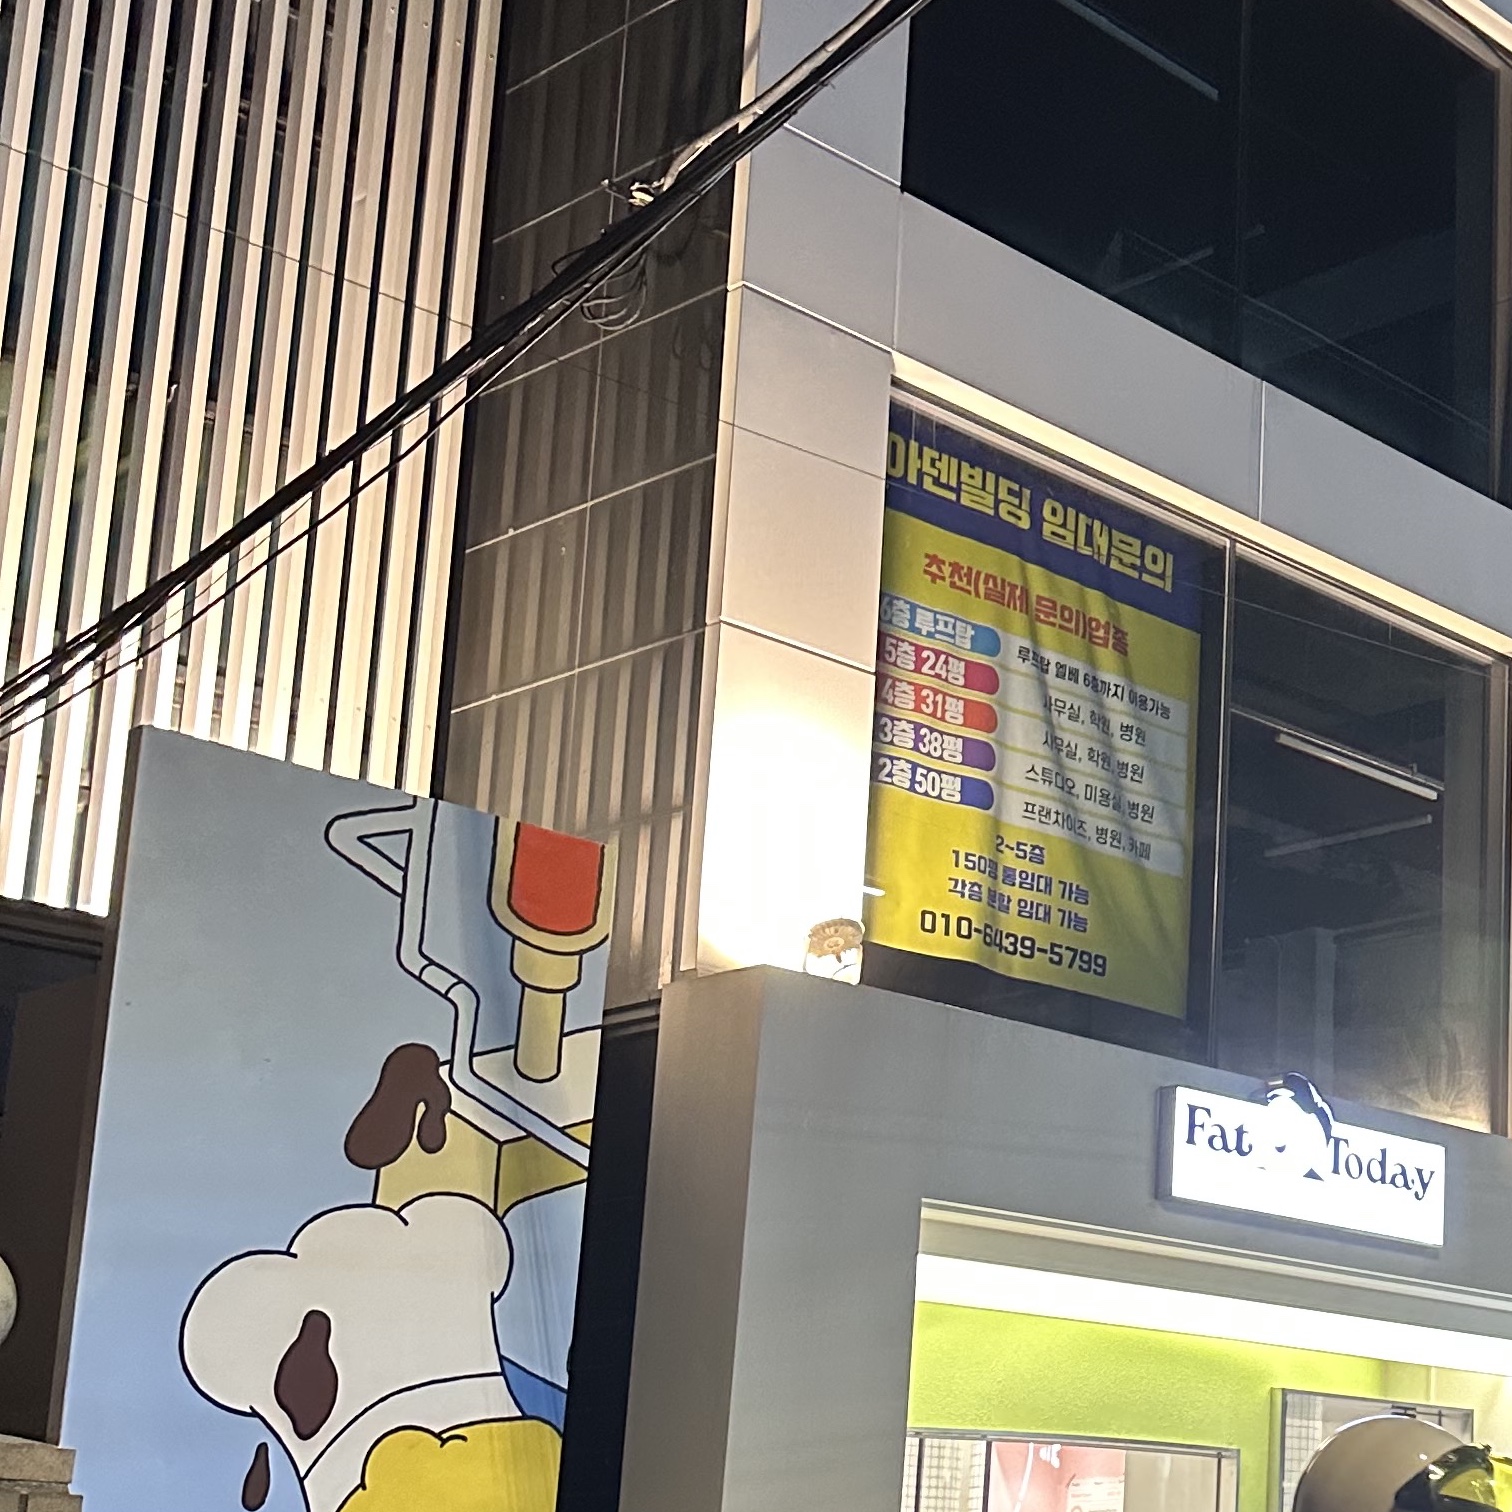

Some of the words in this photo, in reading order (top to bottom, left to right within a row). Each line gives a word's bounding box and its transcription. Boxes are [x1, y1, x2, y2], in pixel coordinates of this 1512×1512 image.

[887, 431, 1032, 531] 아덴빌딩
[1042, 498, 1174, 594] 임대문의
[923, 552, 1030, 616] 추천(실제
[880, 596, 911, 629] 6층
[915, 607, 976, 650] 루프탑
[884, 636, 916, 671] 5층
[920, 649, 966, 687] 24평
[881, 677, 916, 710] 4층
[920, 688, 965, 726] 31평
[878, 716, 916, 749] 3층
[918, 727, 964, 764] 38평
[1119, 721, 1147, 747] 병원
[877, 757, 913, 789] 2층
[914, 766, 962, 803] 50평
[1116, 759, 1145, 784] 병원
[995, 834, 1046, 865] 2~5층
[952, 849, 999, 881] 150평
[1058, 880, 1090, 906] 가능
[948, 877, 984, 903] 각층
[1017, 898, 1052, 924] 임대
[1057, 908, 1088, 934] 가능
[920, 908, 1108, 977] 010-6439-5799
[1186, 1103, 1254, 1157] Fat
[1328, 1134, 1436, 1202] Today
